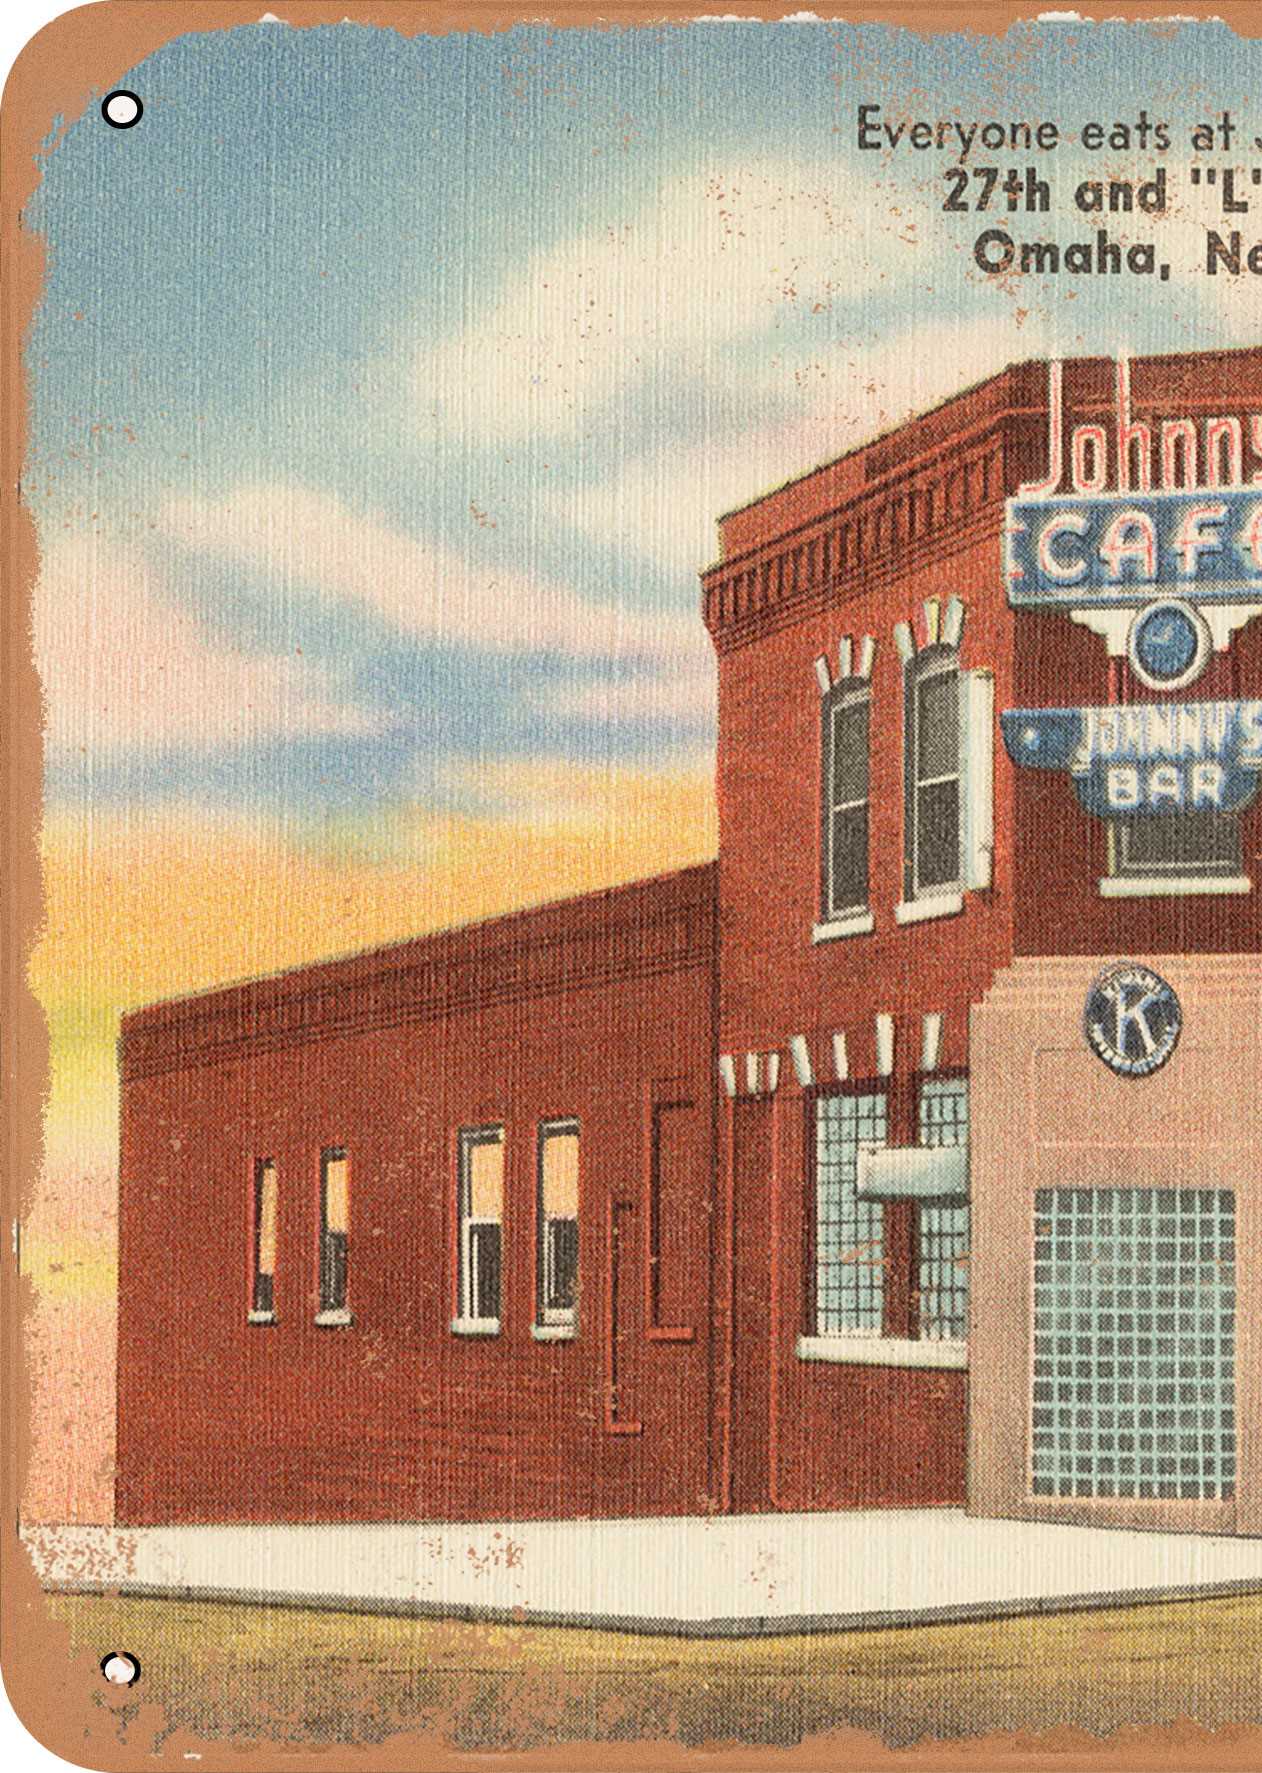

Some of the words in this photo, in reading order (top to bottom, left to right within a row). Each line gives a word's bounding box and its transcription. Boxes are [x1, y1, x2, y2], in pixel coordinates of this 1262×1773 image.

[856, 105, 1060, 164] Everyone
[1080, 108, 1170, 152] eats
[1189, 109, 1237, 152] at
[941, 168, 1052, 214] 27th
[1074, 168, 1168, 214] and
[973, 229, 1171, 281] Omaha,
[1106, 763, 1226, 808] BAR
[1101, 984, 1170, 1056] K
